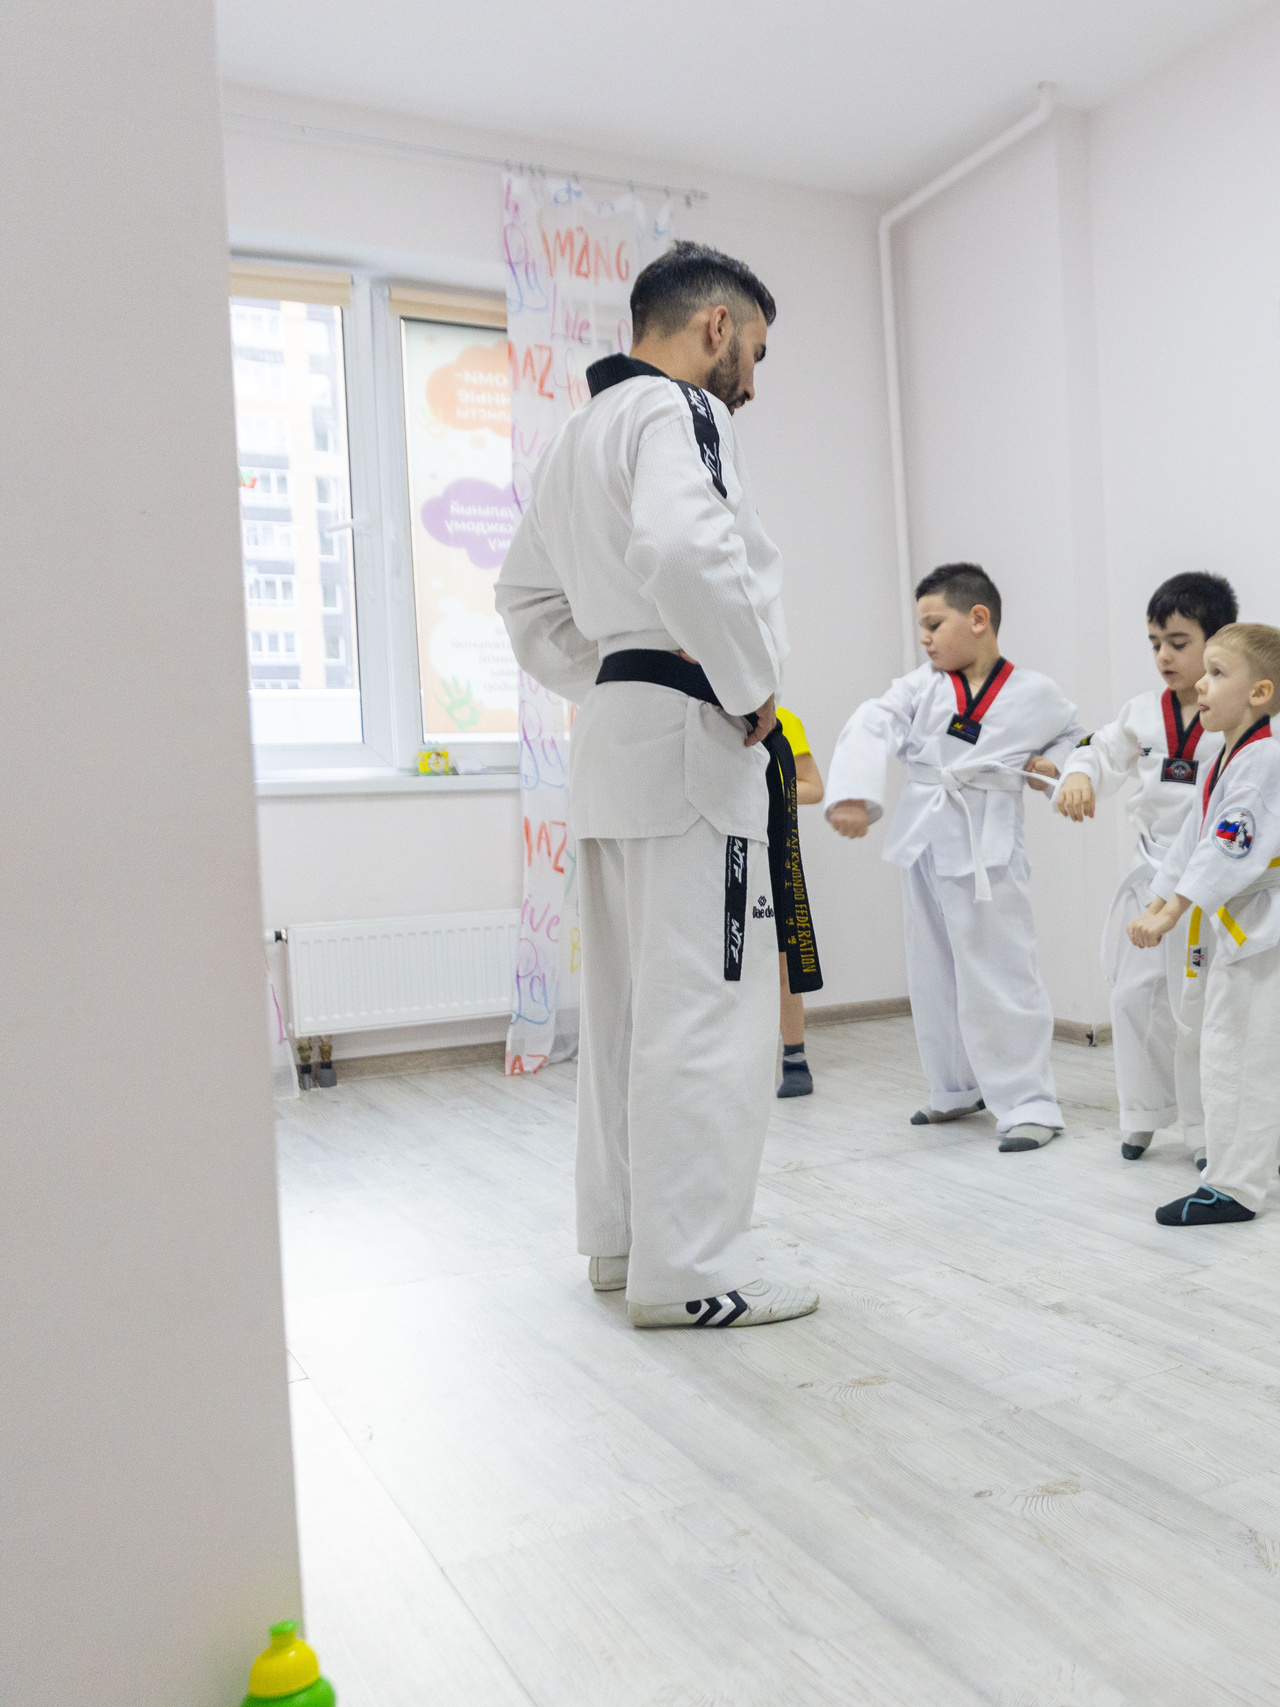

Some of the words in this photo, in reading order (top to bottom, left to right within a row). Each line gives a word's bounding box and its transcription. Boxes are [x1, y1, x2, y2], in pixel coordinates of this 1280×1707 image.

[734, 838, 746, 884] WTF
[731, 918, 743, 964] WTF
[795, 903, 817, 973] FEDERATION
